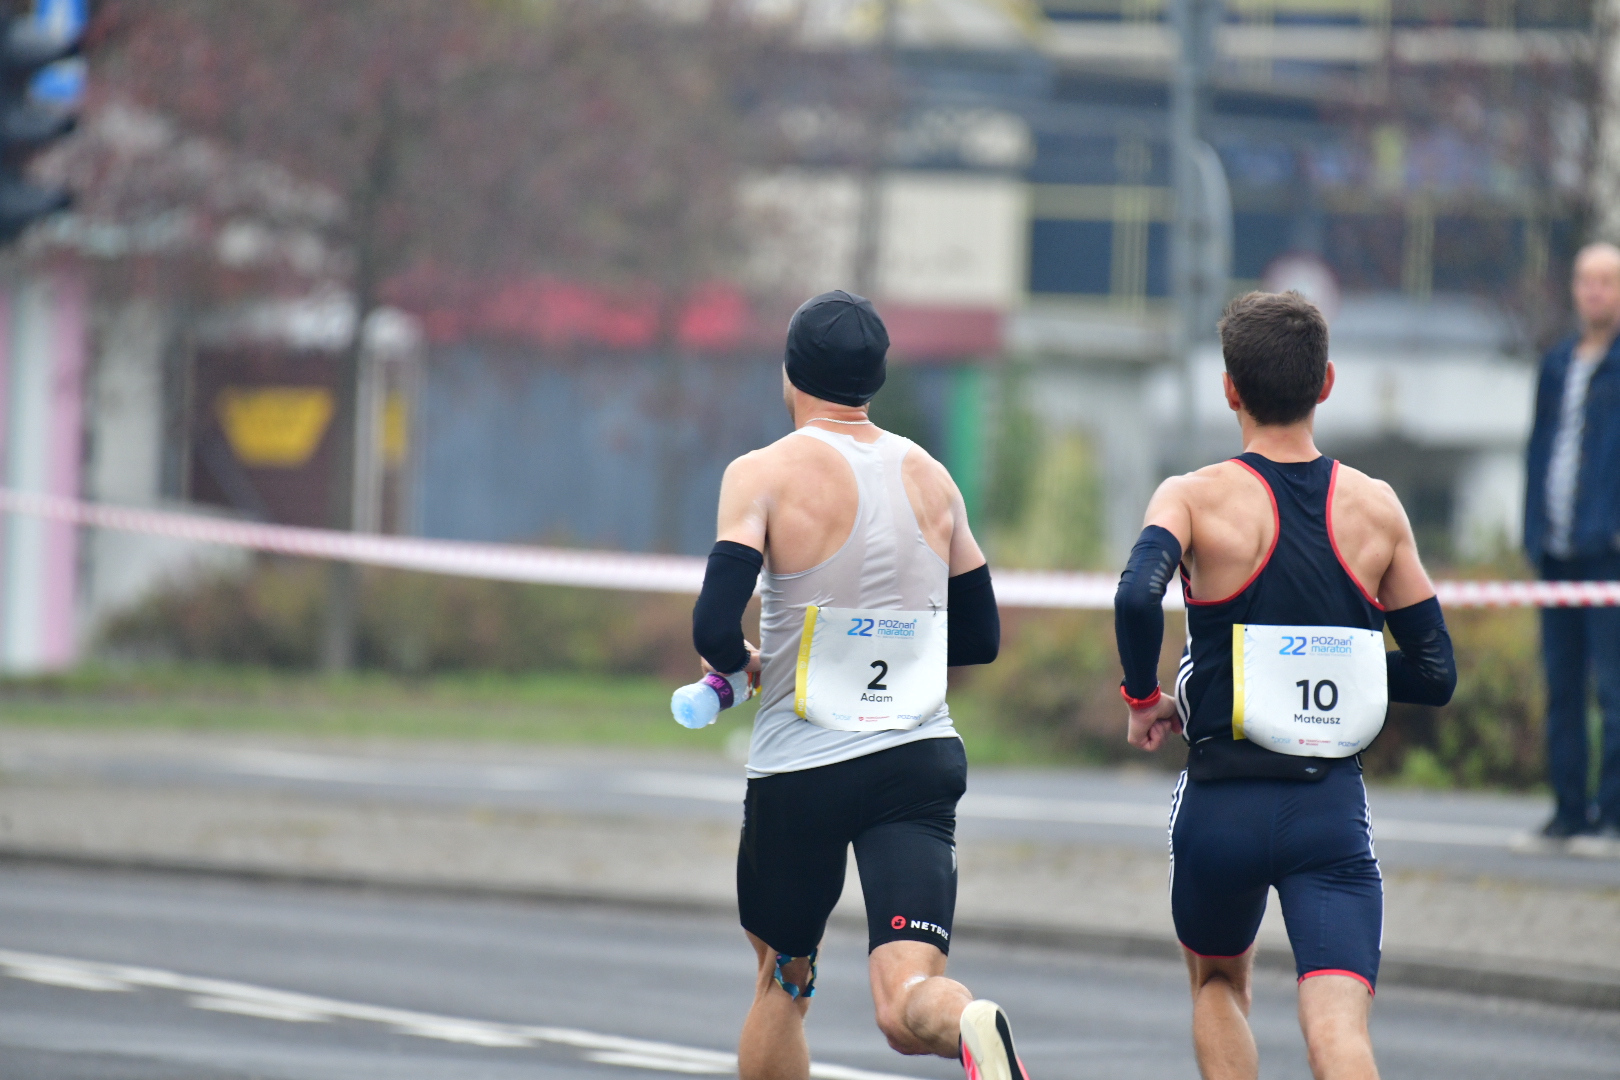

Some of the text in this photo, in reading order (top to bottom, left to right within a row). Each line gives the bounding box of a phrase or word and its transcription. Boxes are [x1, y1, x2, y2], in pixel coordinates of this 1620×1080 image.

[847, 618, 875, 637] 22
[877, 628, 915, 637] maraton
[1279, 636, 1307, 655] 22
[1311, 645, 1352, 653] maraton
[867, 660, 888, 690] 2
[860, 693, 893, 702] Adam
[1295, 679, 1339, 711] 10
[1294, 713, 1341, 724] Mateusz
[910, 919, 949, 940] NETBOX
